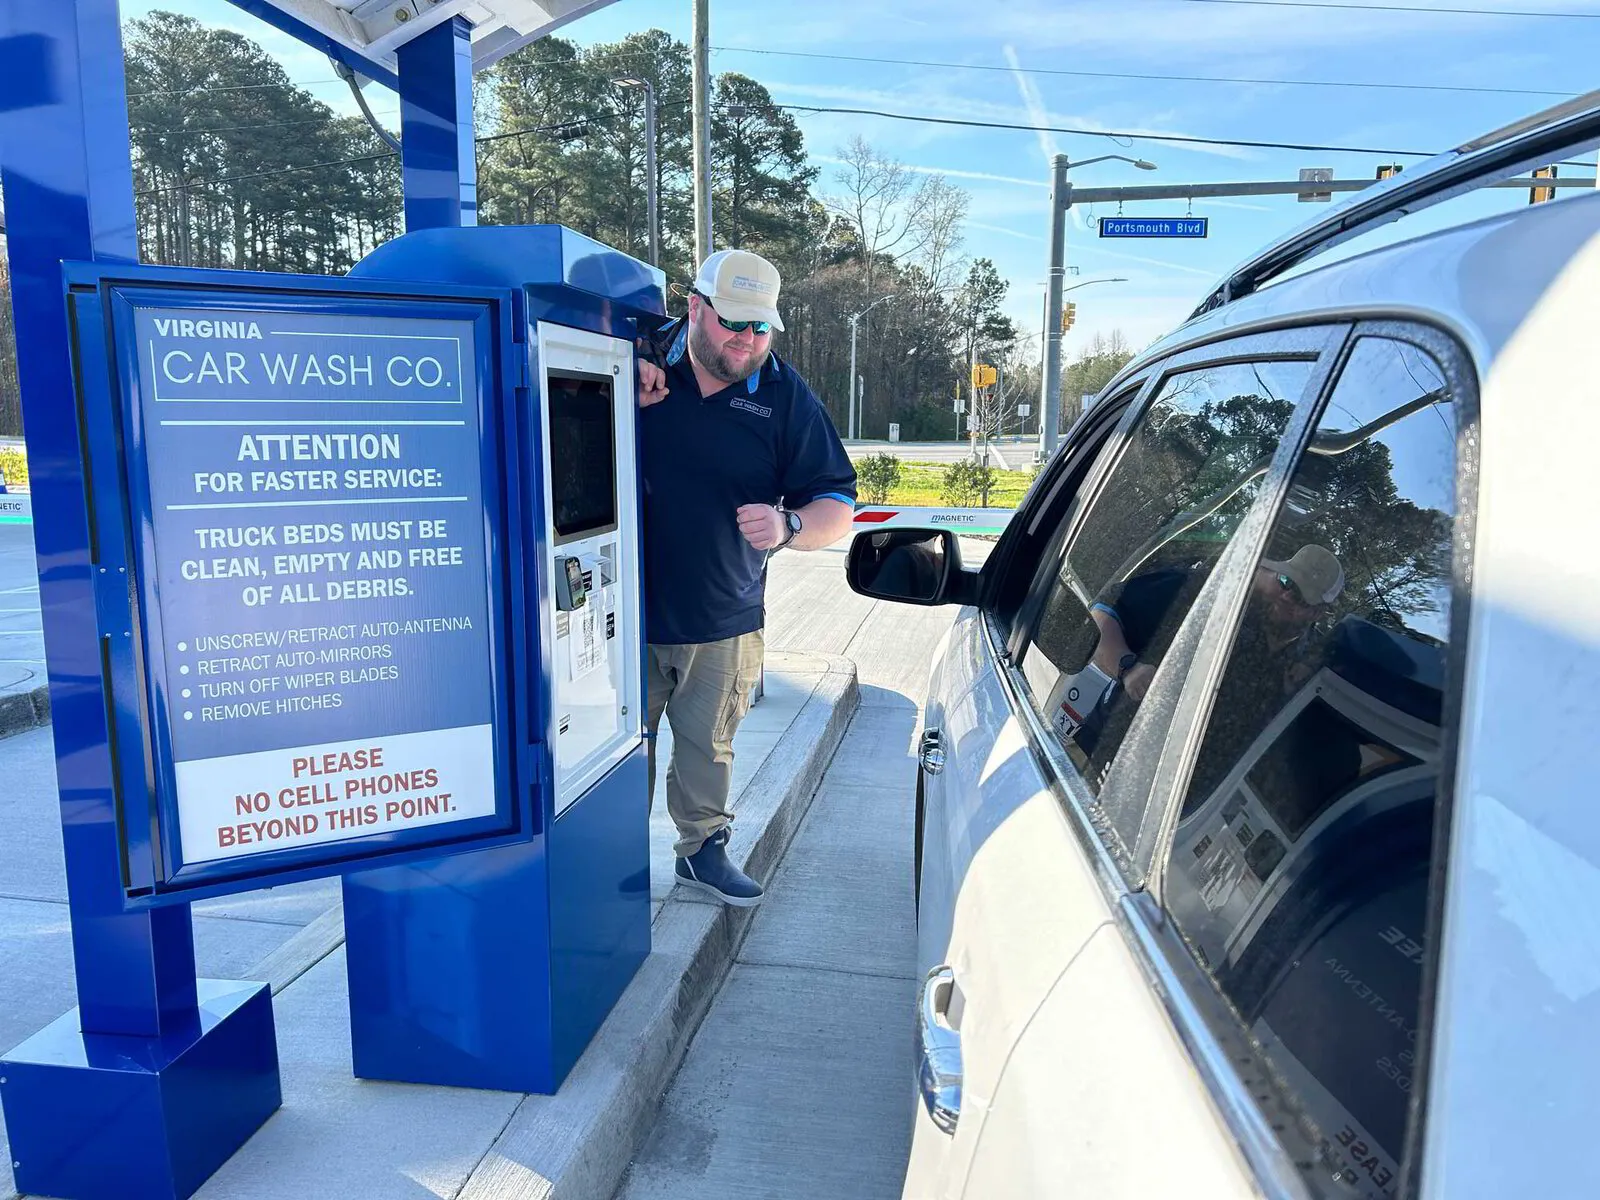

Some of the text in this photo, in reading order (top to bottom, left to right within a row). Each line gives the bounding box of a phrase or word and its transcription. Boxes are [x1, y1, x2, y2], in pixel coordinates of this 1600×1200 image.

[1107, 222, 1200, 233] Portsmouth Blvd
[153, 318, 263, 340] VIRGINIA
[162, 350, 452, 388] CAR WASH CO.
[237, 433, 400, 462] ATTENTION
[194, 468, 442, 493] FOR FASTER SERVICE:
[194, 519, 448, 550] TRUCK BEDS MUST BE
[180, 546, 463, 581] CLEAN, EMPTY AND FREE
[242, 577, 414, 607] OF ALL DEBRIS.
[195, 616, 473, 653] UNSCREW/RETRACT AUTO-ANTENNA
[198, 644, 392, 676] RETRACT AUTO-MIRRORS
[199, 665, 399, 699] TURN OFF WIPER BLADES
[202, 693, 343, 722] REMOVE HITCHES
[292, 747, 384, 778] PLEASE
[235, 768, 439, 816] NO CELL PHONES
[217, 793, 457, 848] BEYOND THIS POINT.
